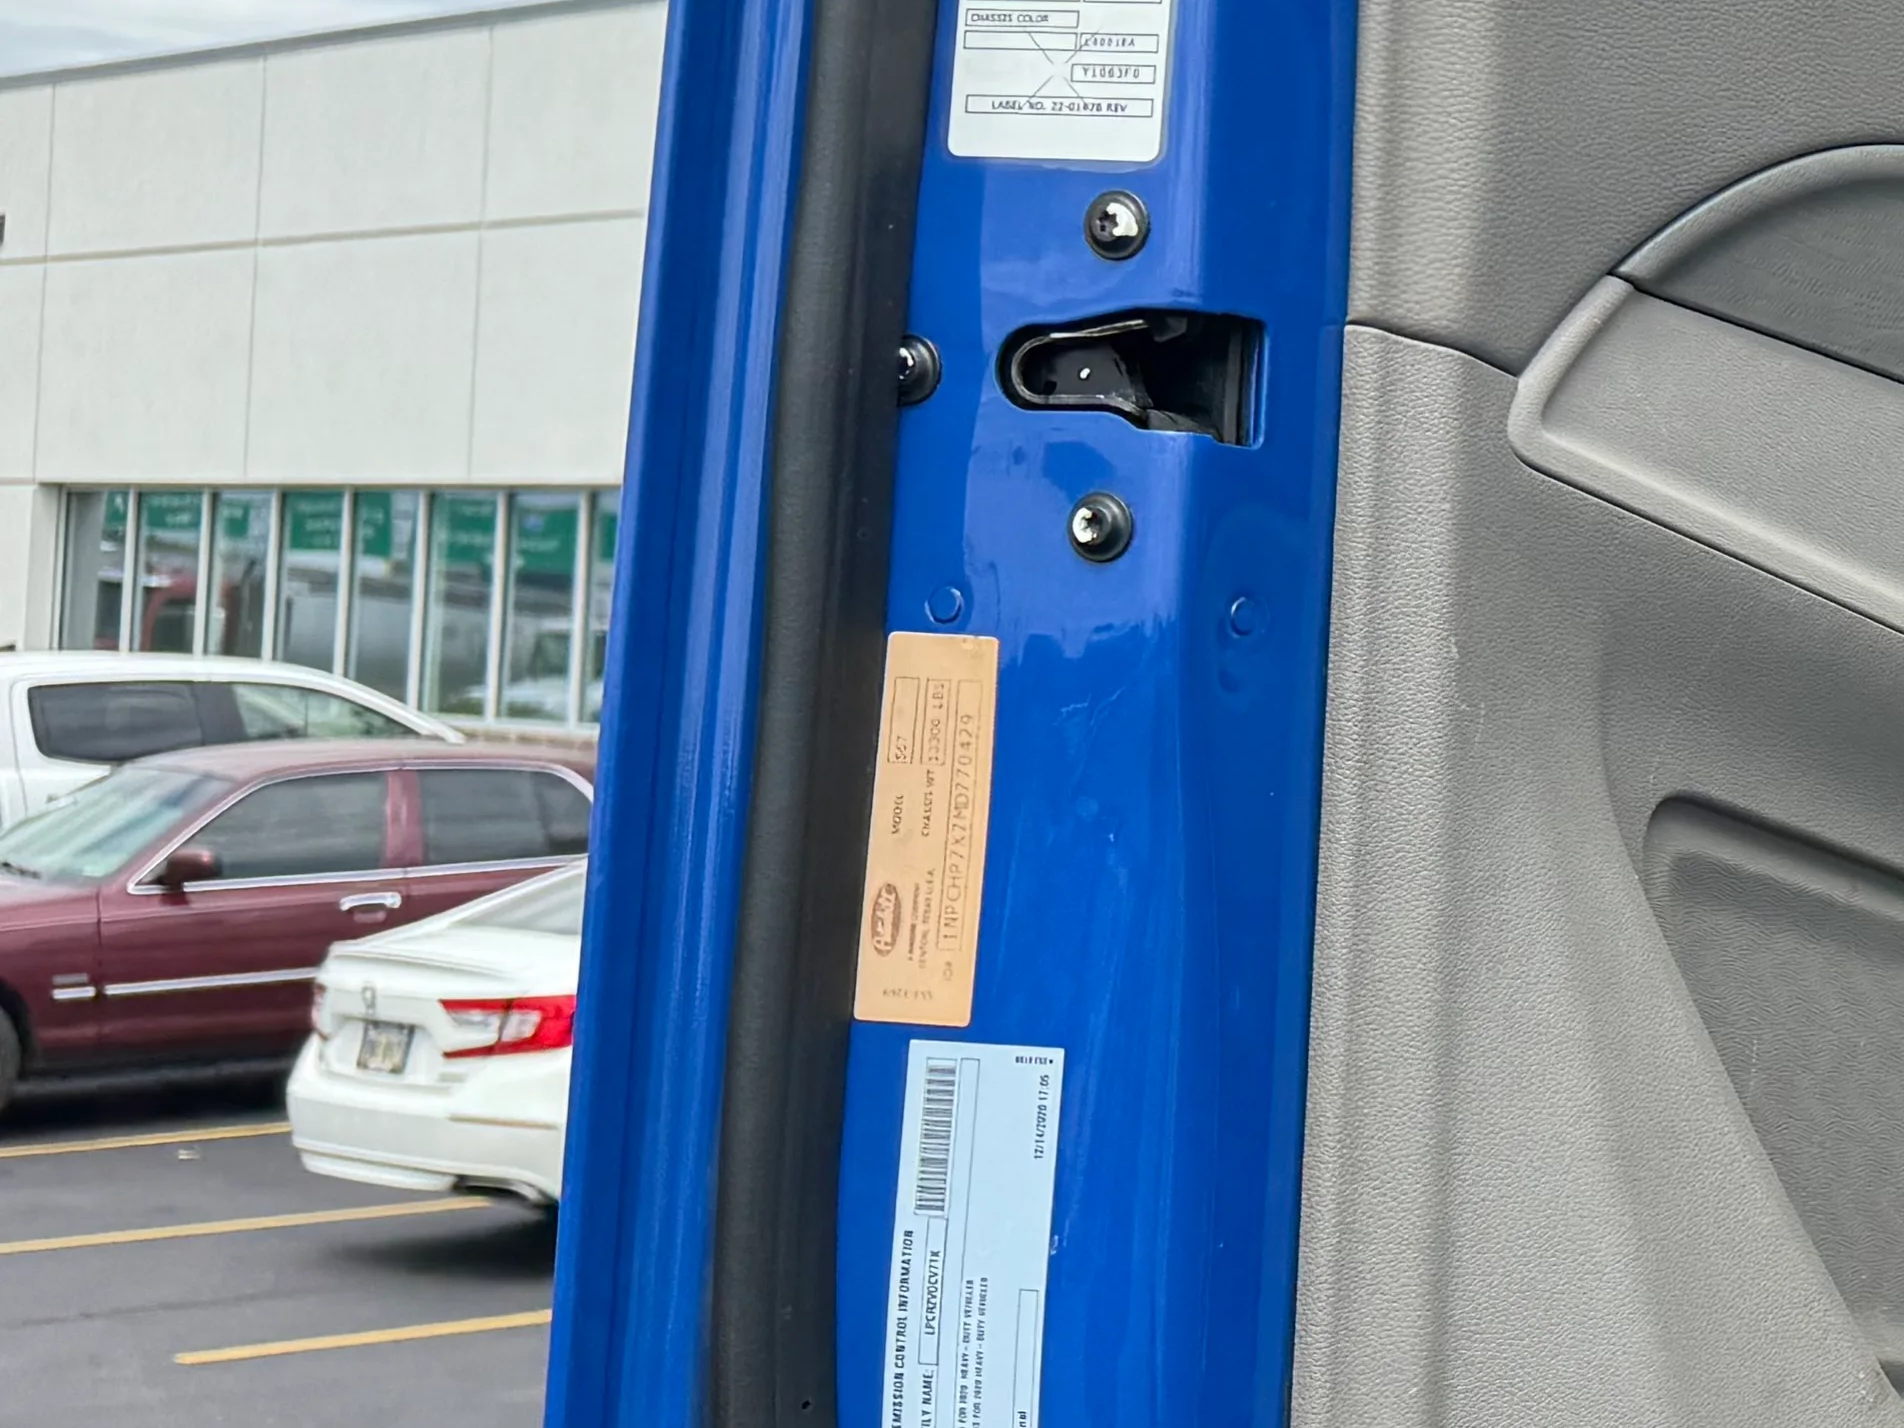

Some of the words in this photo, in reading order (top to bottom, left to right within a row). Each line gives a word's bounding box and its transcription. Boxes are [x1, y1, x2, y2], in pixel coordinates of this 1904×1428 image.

[971, 14, 1012, 22] CHASSIS
[1017, 14, 1049, 23] COLOR
[1106, 103, 1128, 113] REV
[897, 1230, 914, 1312] INFORMATION
[893, 1316, 908, 1369] CONTROL
[921, 1370, 934, 1405] NAME:
